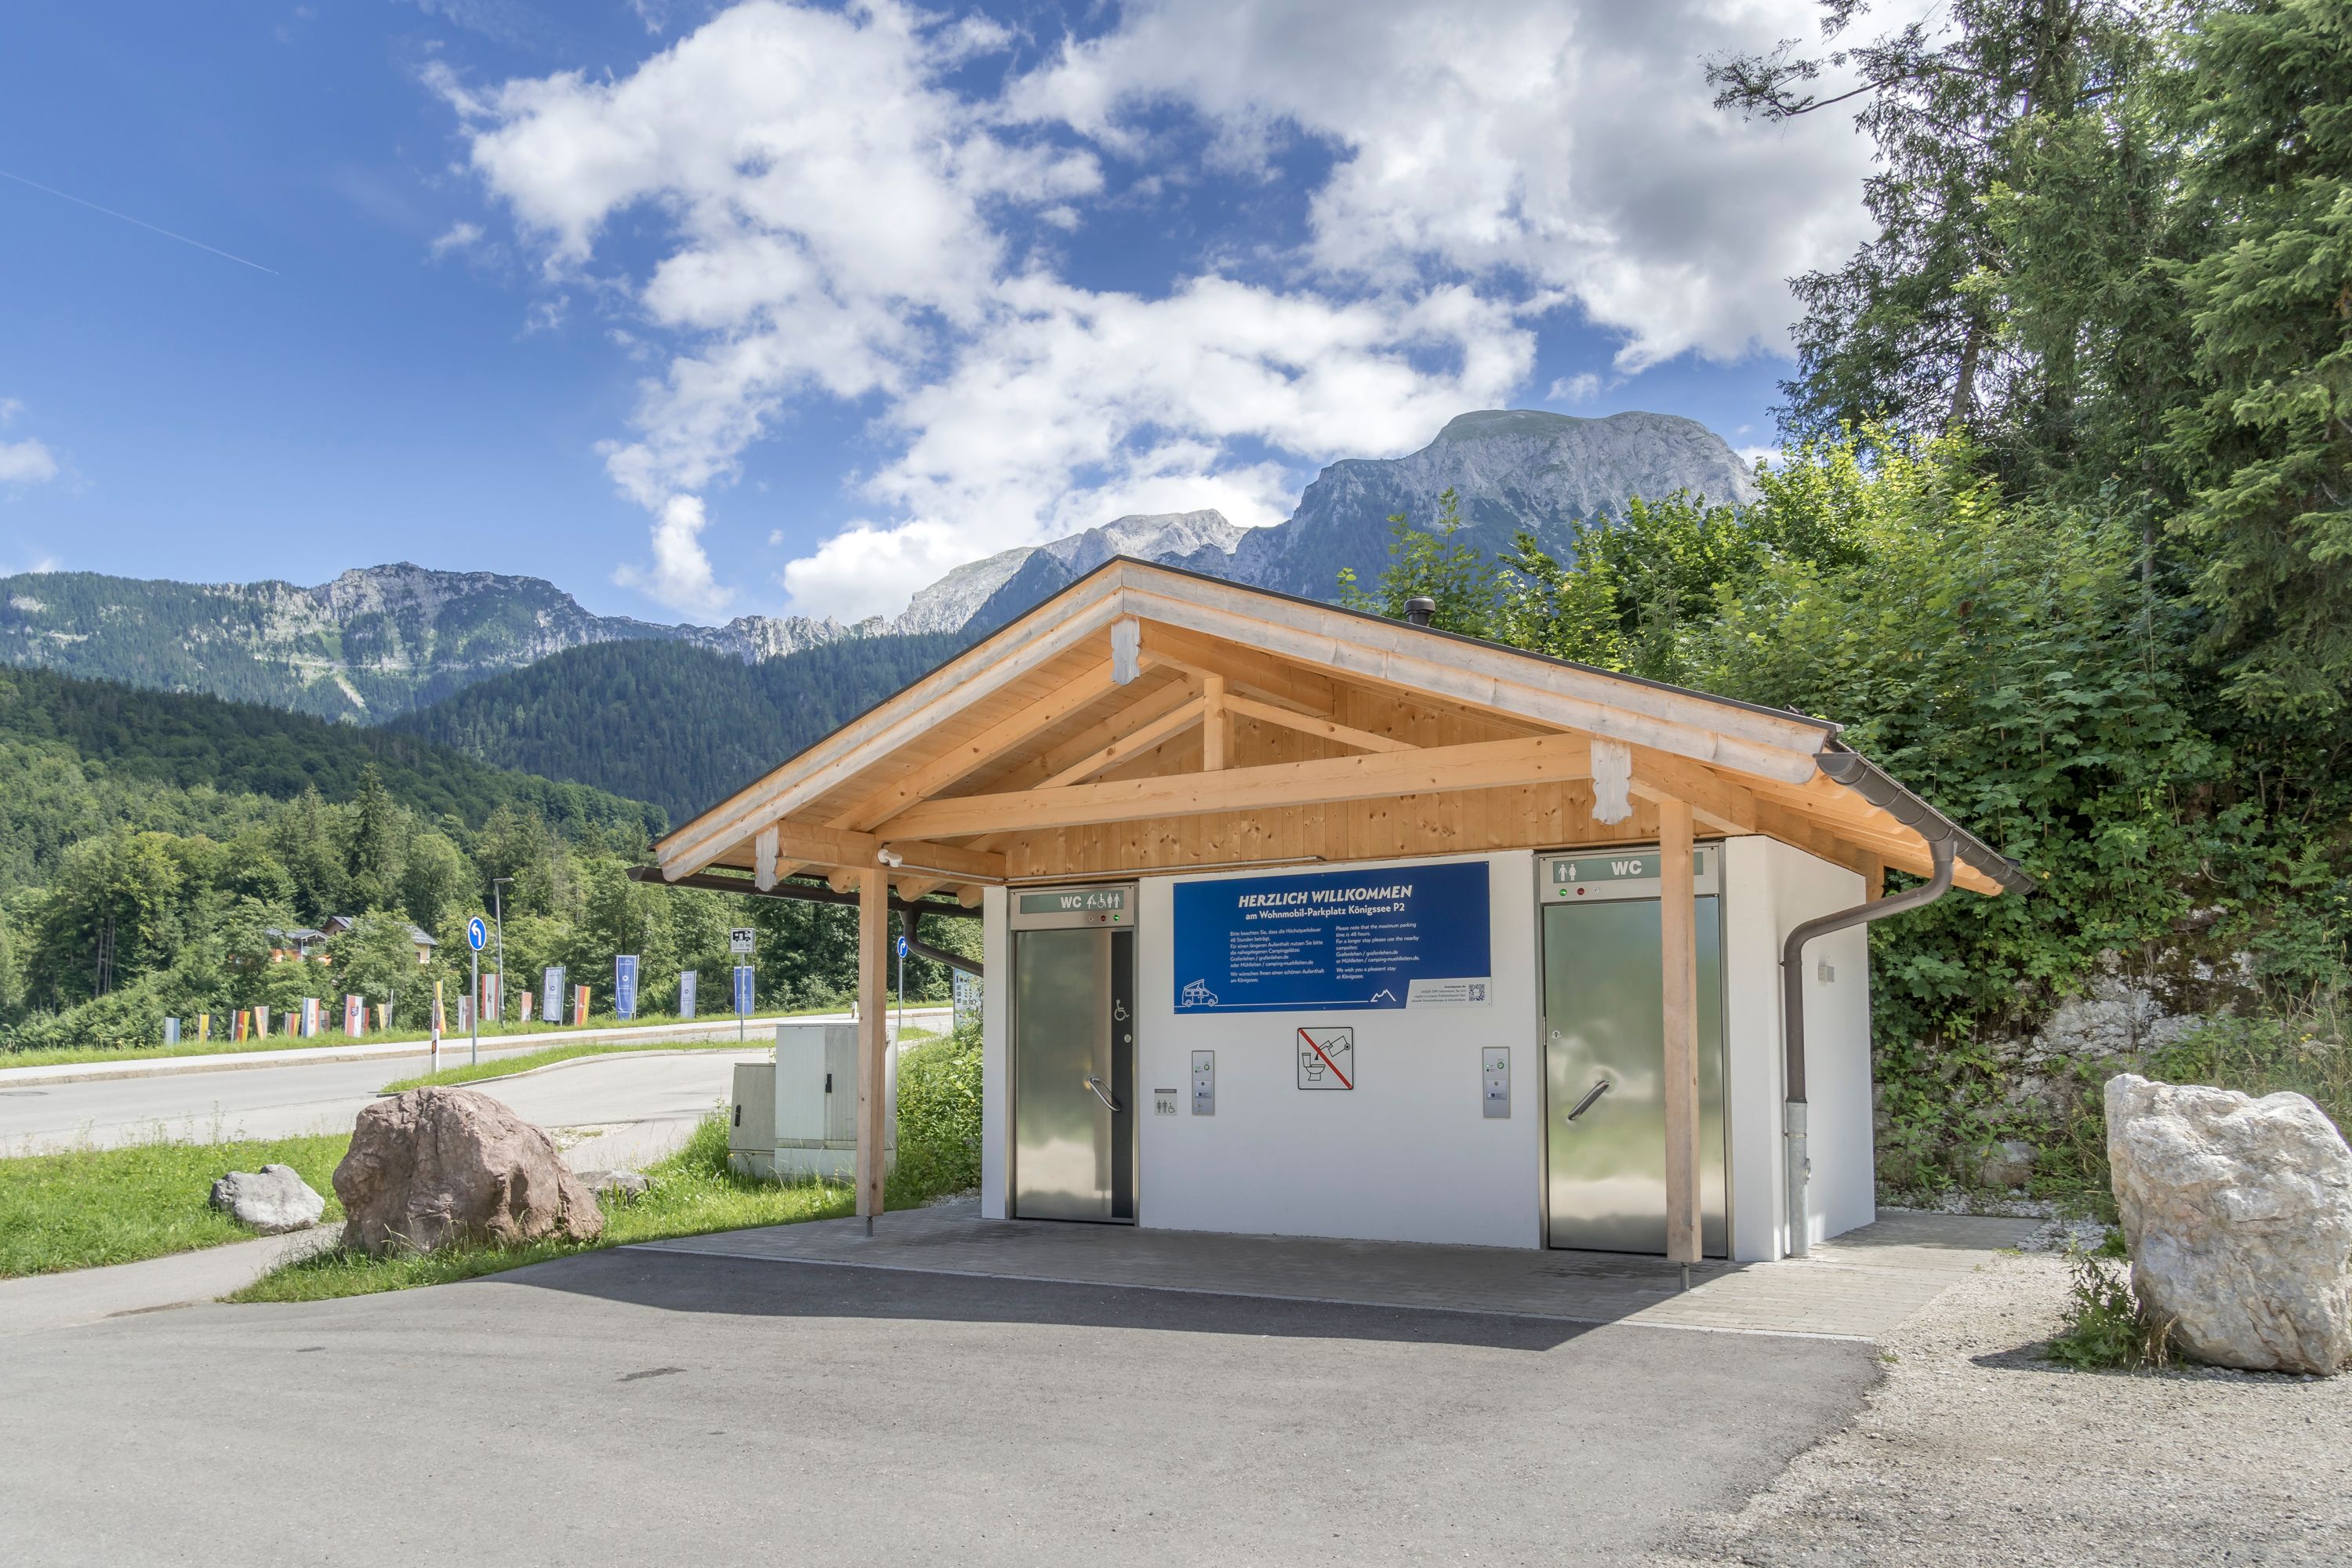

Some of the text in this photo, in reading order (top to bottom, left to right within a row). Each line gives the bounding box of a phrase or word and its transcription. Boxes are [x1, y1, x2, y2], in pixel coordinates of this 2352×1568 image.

[1611, 860, 1642, 875] WC
[1060, 896, 1081, 908] WC
[1239, 885, 1412, 907] HERZLICH WILLKOMMEN
[1260, 906, 1346, 919] Wohnmobil-Parkplatz
[1348, 904, 1391, 915] Königssee
[1393, 903, 1405, 912] P2
